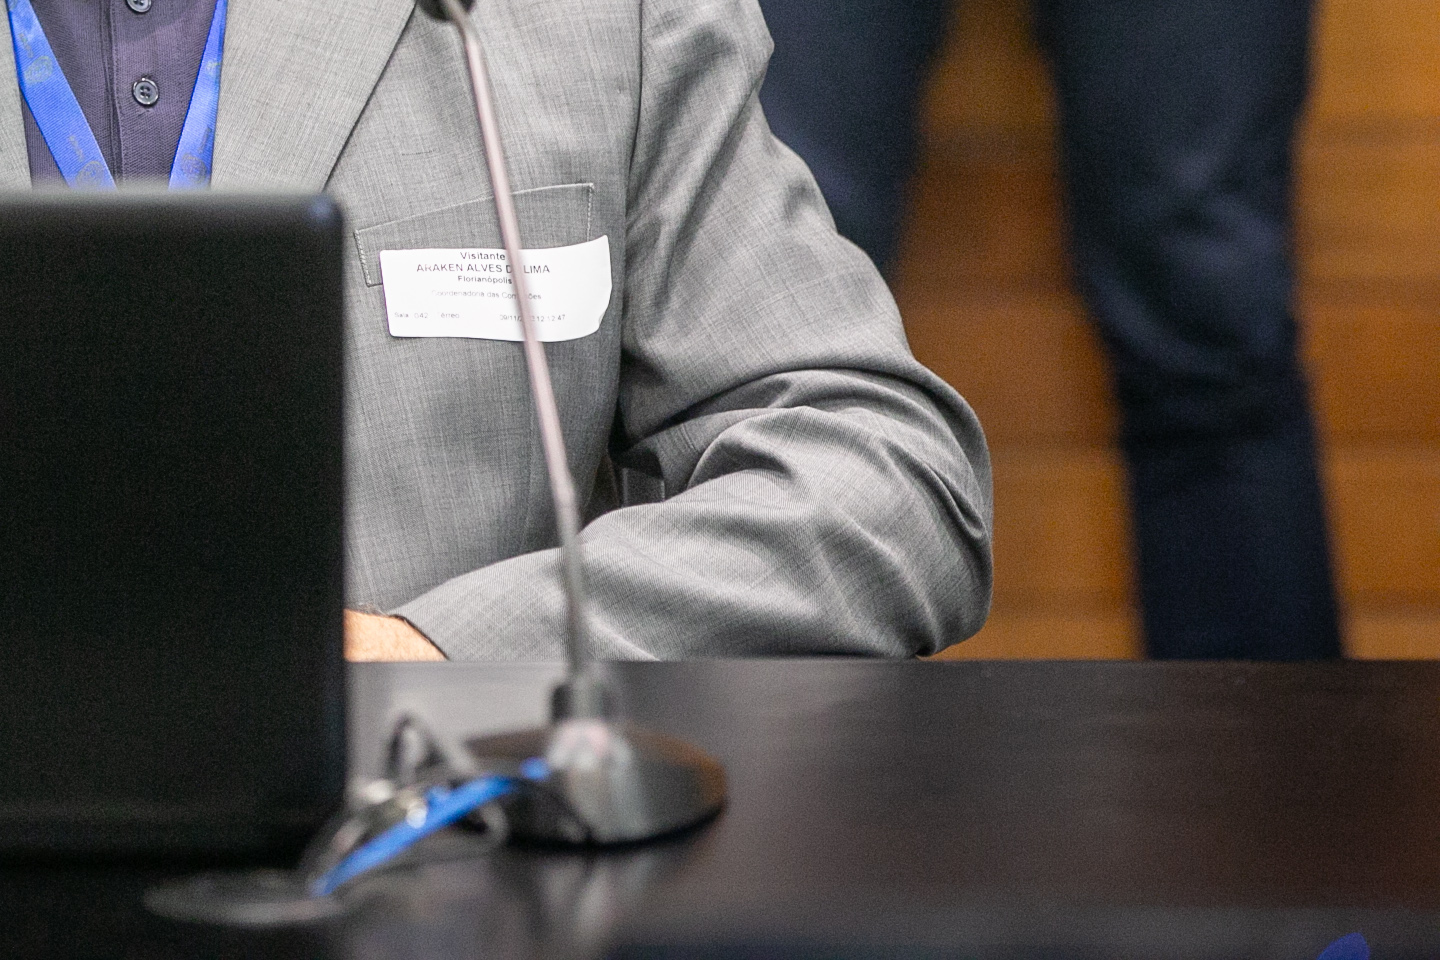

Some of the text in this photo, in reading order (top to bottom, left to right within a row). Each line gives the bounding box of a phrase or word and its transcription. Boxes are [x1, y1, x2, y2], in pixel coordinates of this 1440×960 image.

[460, 251, 506, 261] Visitante
[416, 263, 464, 272] ARAKEN
[466, 264, 503, 273] ALVES
[523, 265, 551, 274] LIMA
[457, 275, 513, 285] Florianópolis
